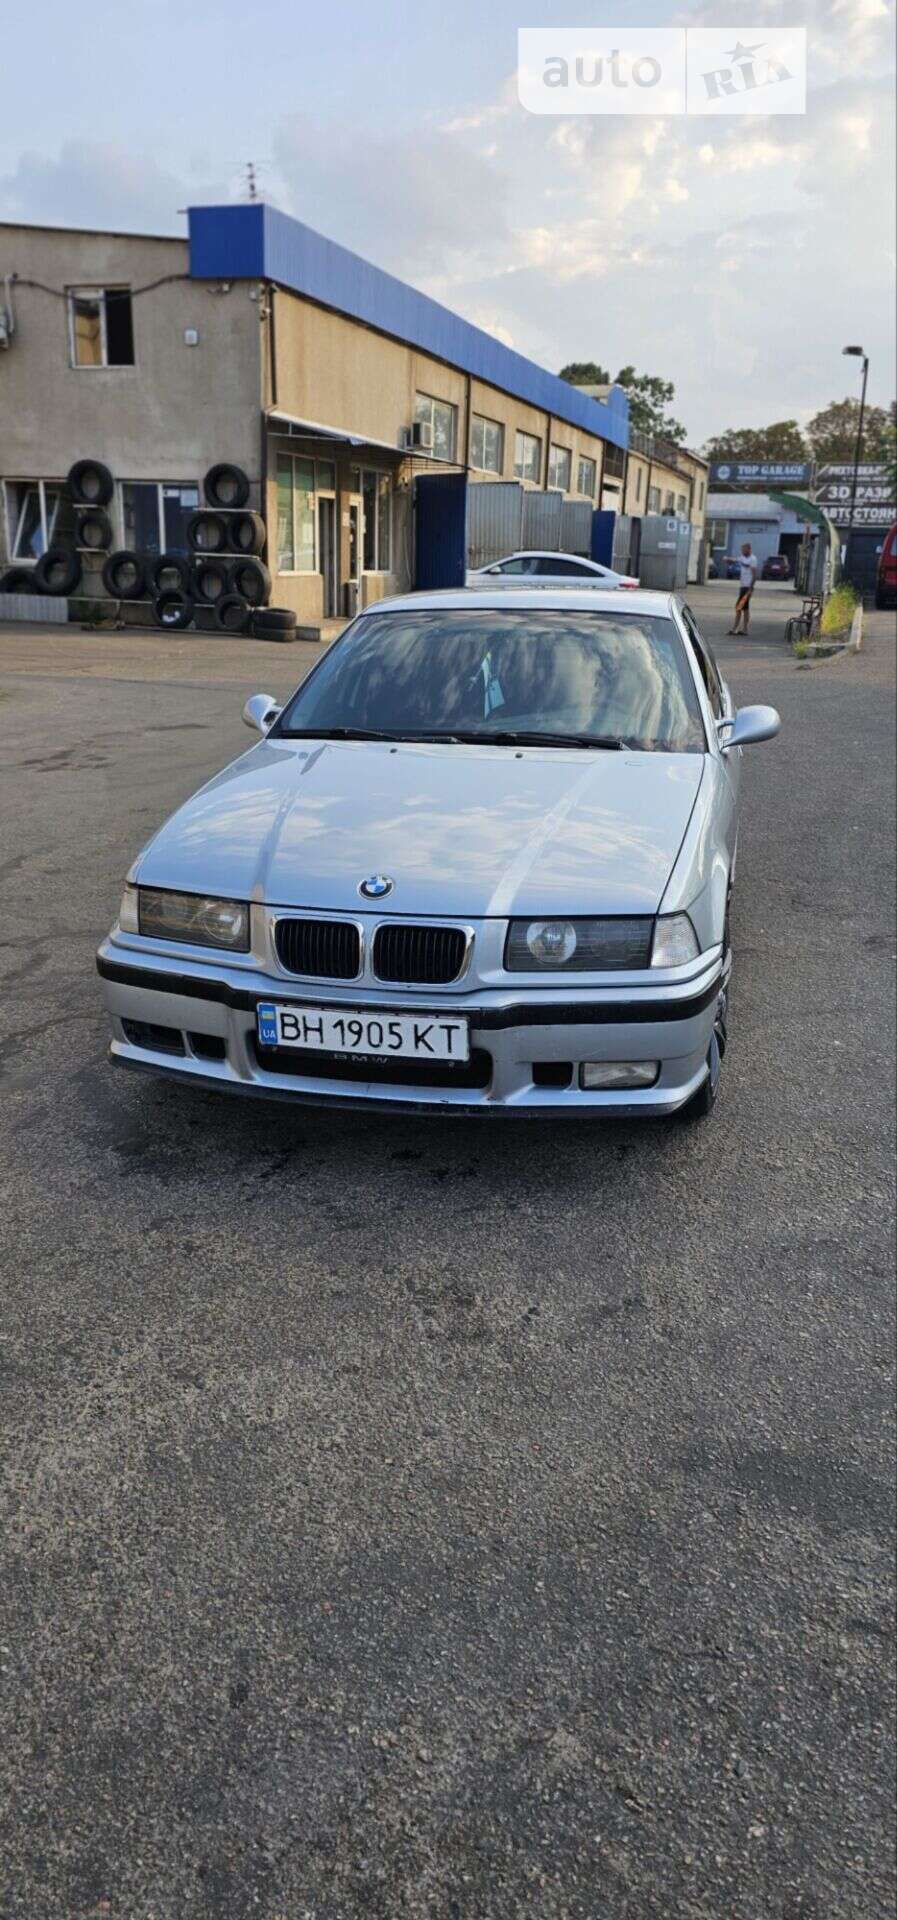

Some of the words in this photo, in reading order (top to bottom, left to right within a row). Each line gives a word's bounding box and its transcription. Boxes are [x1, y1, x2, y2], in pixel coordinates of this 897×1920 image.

[738, 465, 759, 475] TOP
[761, 465, 804, 475] GARAGE
[828, 486, 850, 499] 3D
[263, 1028, 276, 1039] UA
[280, 1013, 324, 1044] BH
[332, 1019, 403, 1049] 1905
[413, 1024, 460, 1053] KT
